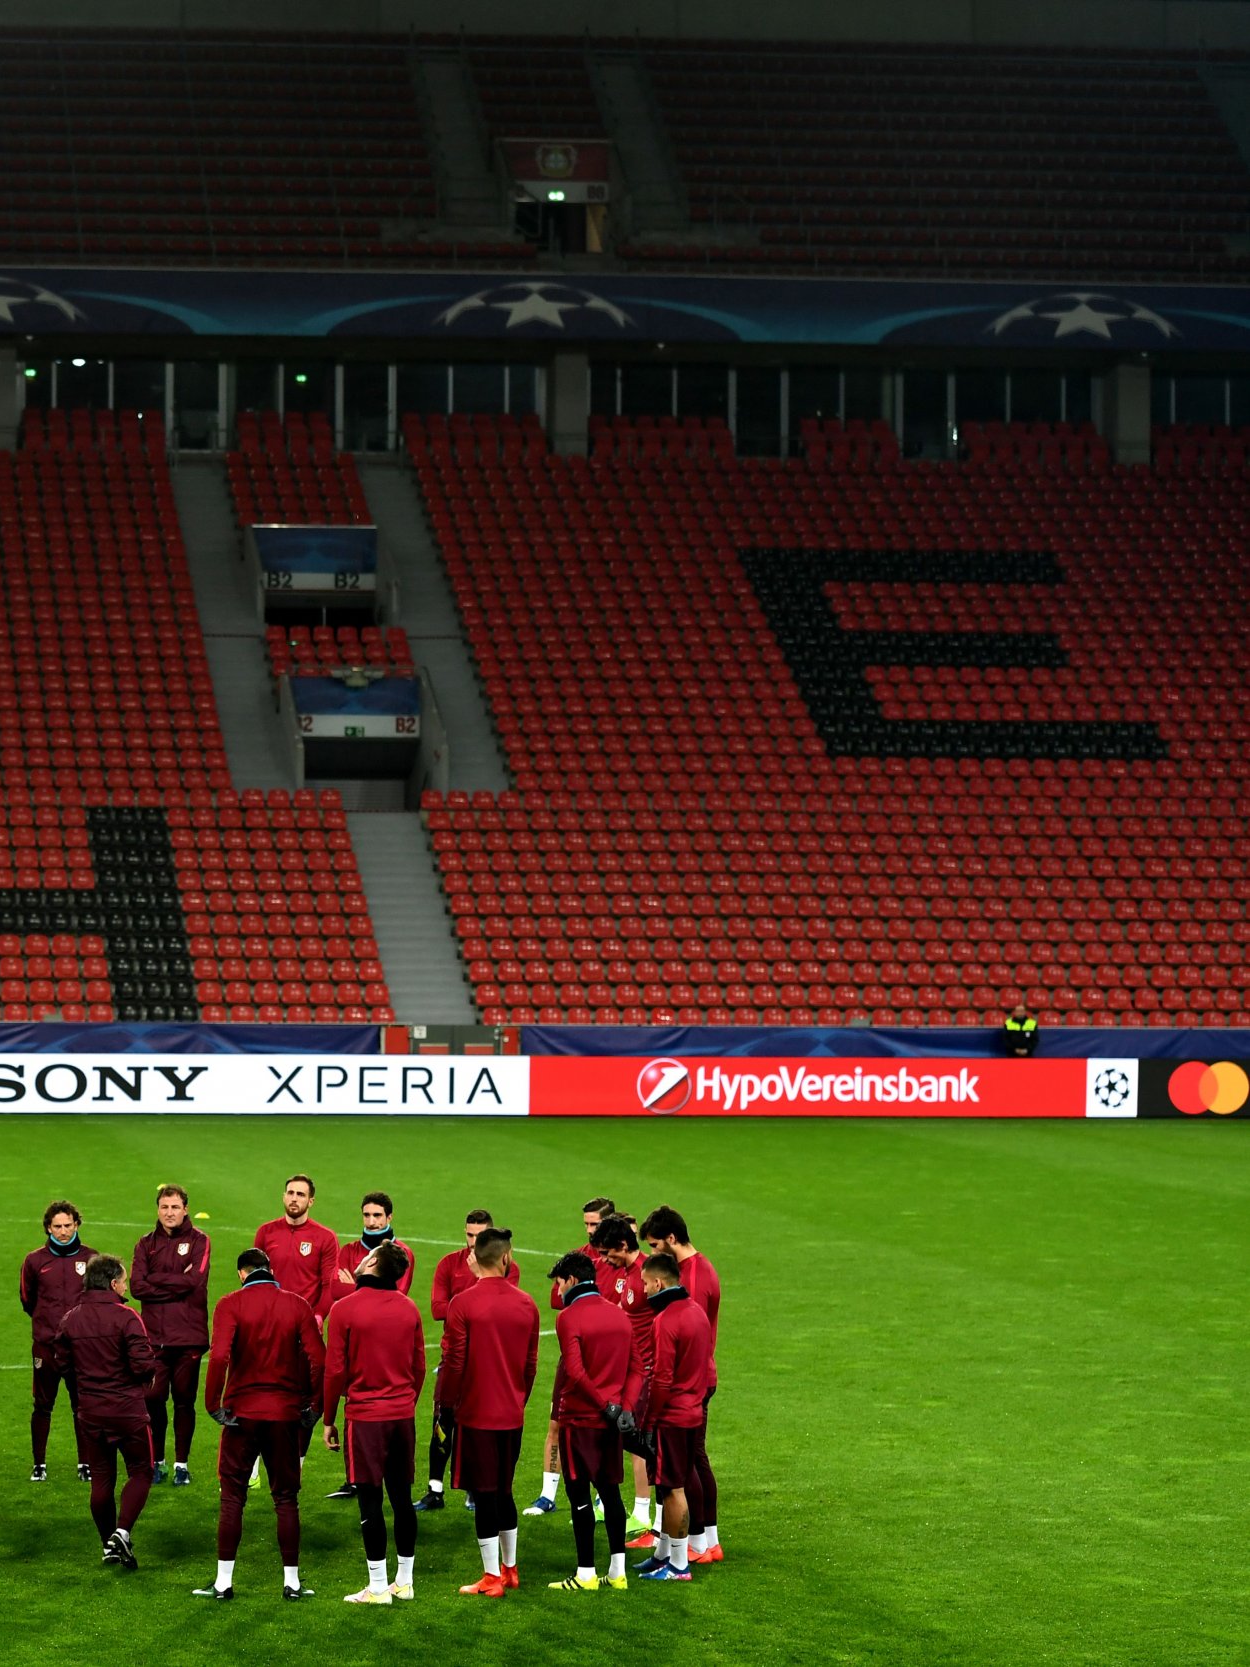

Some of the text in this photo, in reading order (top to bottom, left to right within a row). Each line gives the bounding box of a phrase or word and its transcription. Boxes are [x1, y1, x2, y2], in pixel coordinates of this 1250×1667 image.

[267, 573, 292, 589] B2
[335, 573, 359, 588] B2
[395, 717, 416, 734] B2
[267, 1066, 502, 1104] XPERIA
[696, 1065, 980, 1110] HypoVereinsbank
